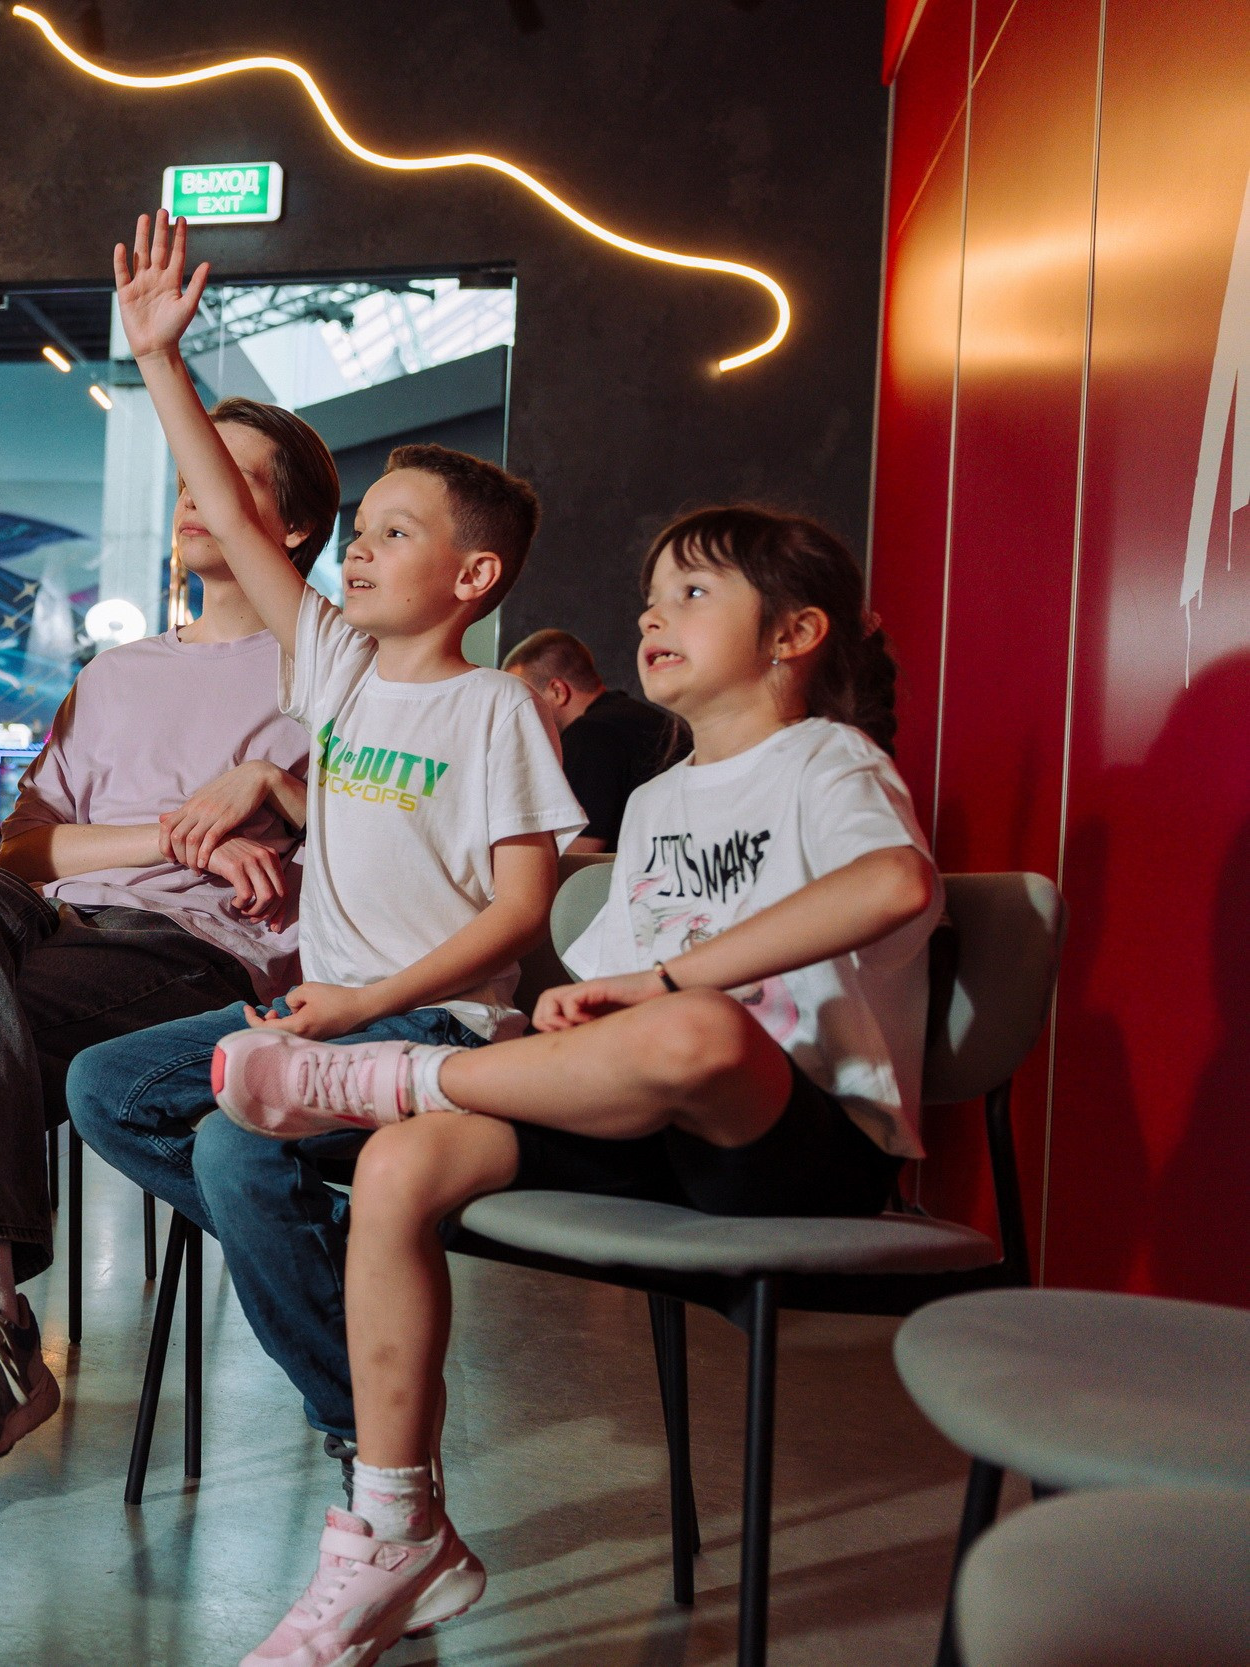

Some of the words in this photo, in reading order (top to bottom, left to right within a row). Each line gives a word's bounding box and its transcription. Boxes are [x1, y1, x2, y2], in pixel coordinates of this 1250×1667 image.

[181, 170, 260, 195] ВЫХОД
[197, 195, 244, 214] EXIT
[350, 746, 449, 798] DUTY
[701, 829, 770, 904] MAKE
